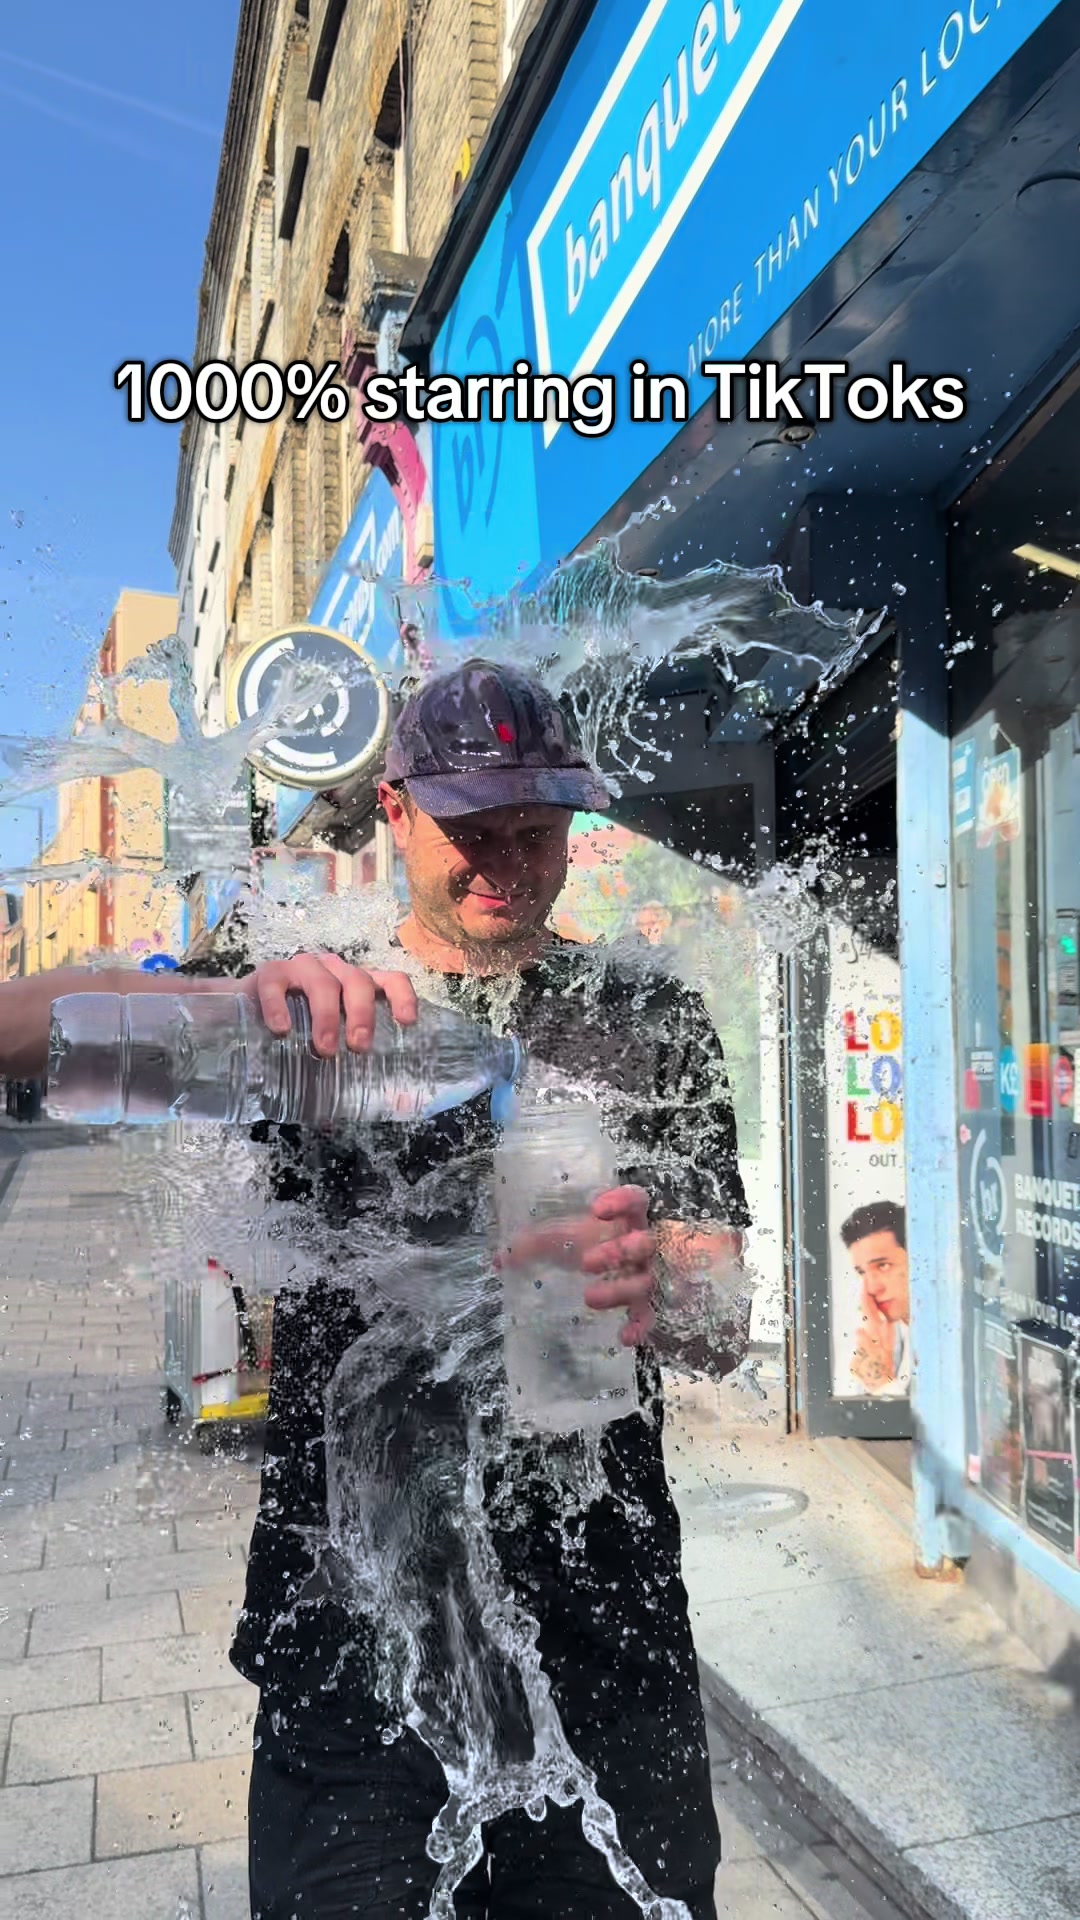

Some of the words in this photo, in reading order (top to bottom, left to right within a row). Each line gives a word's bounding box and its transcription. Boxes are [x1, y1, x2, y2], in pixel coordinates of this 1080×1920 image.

[687, 281, 743, 379] MORE
[754, 185, 819, 296] THAN
[828, 77, 908, 204] YOUR
[921, 0, 1001, 97] LOC
[844, 1009, 902, 1051] LO
[847, 1055, 901, 1097] LO
[847, 1101, 903, 1143] LO
[869, 1154, 897, 1167] OUT
[1014, 1172, 1080, 1212] BANQUET
[1014, 1208, 1080, 1251] RECORDS
